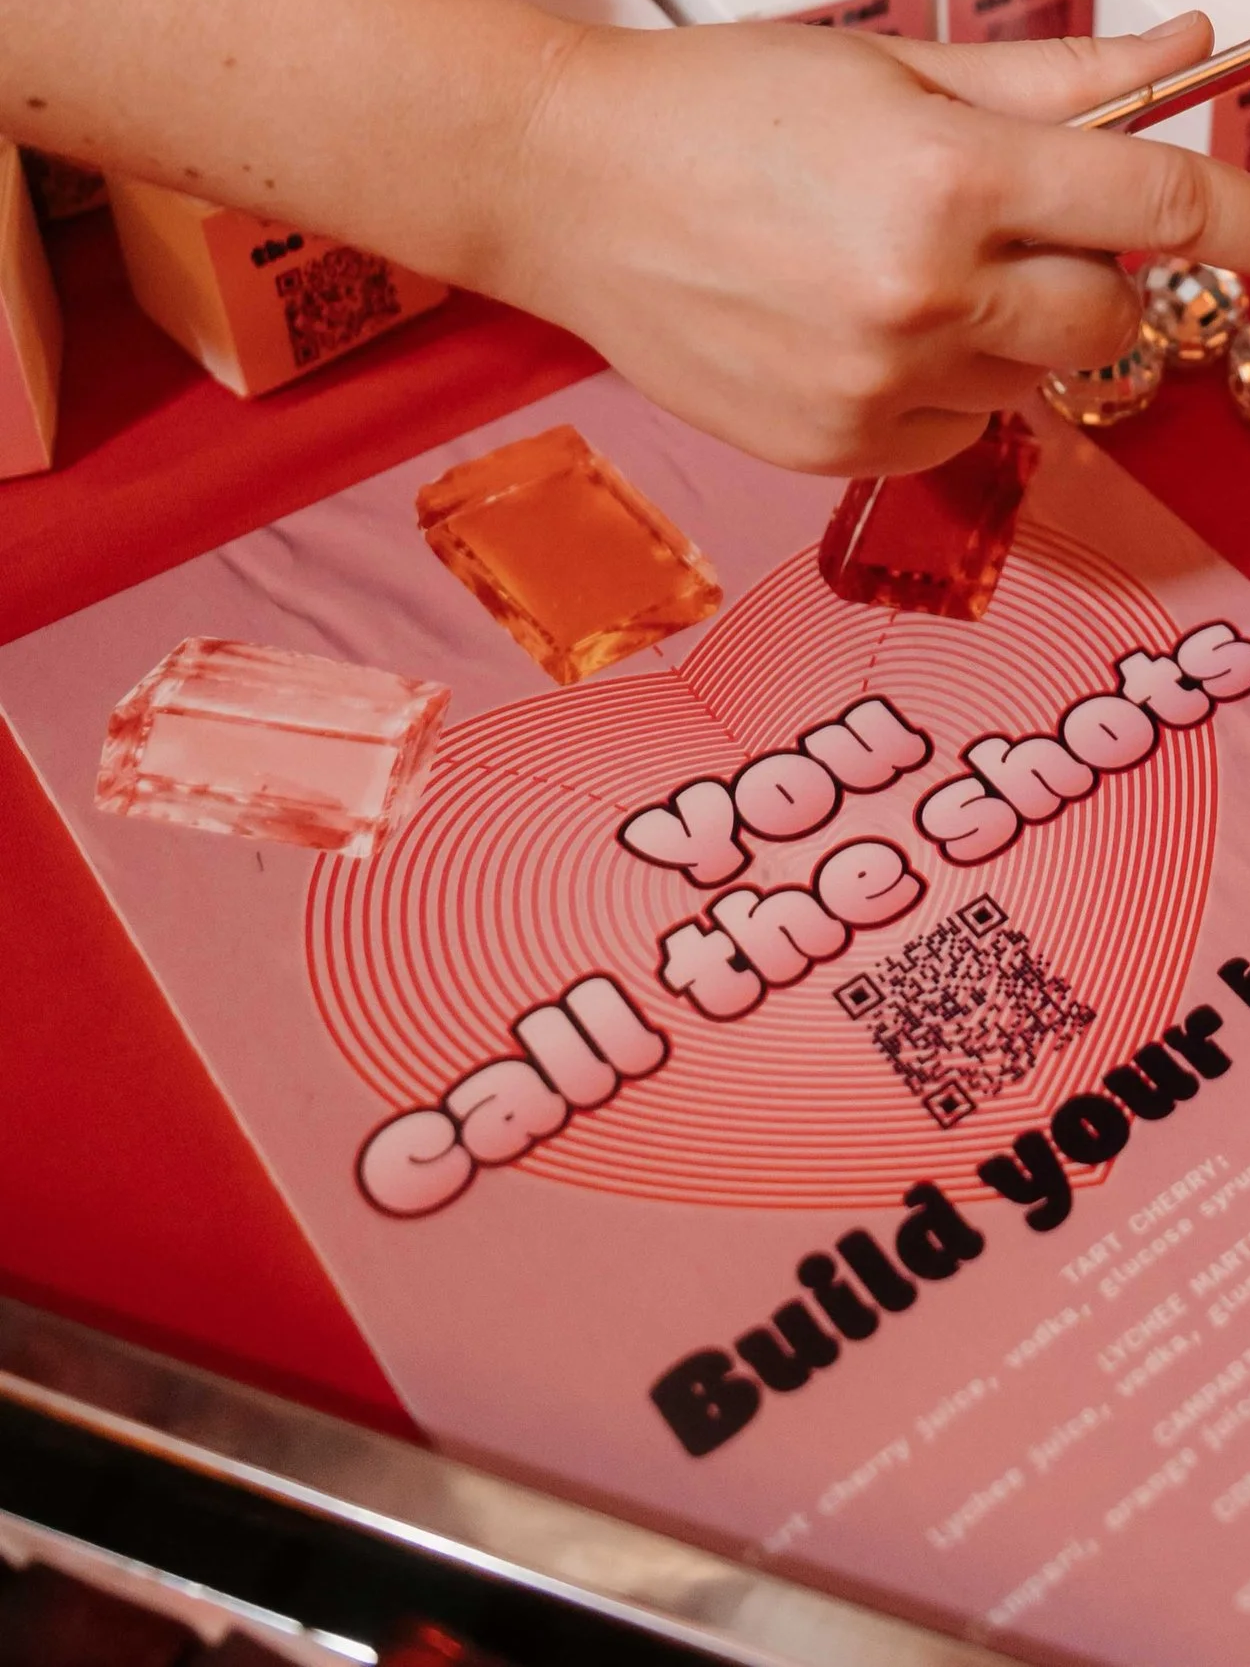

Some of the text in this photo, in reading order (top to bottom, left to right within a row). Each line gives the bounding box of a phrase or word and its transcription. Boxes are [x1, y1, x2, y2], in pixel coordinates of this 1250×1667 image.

[356, 973, 670, 1221] call
[658, 838, 929, 1024] the
[650, 1179, 985, 1458] Build
[982, 1003, 1234, 1232] your
[1060, 1154, 1230, 1284] TART CHERRY:
[1098, 1217, 1194, 1300] glucose
[1097, 1293, 1188, 1373] LYCHEE
